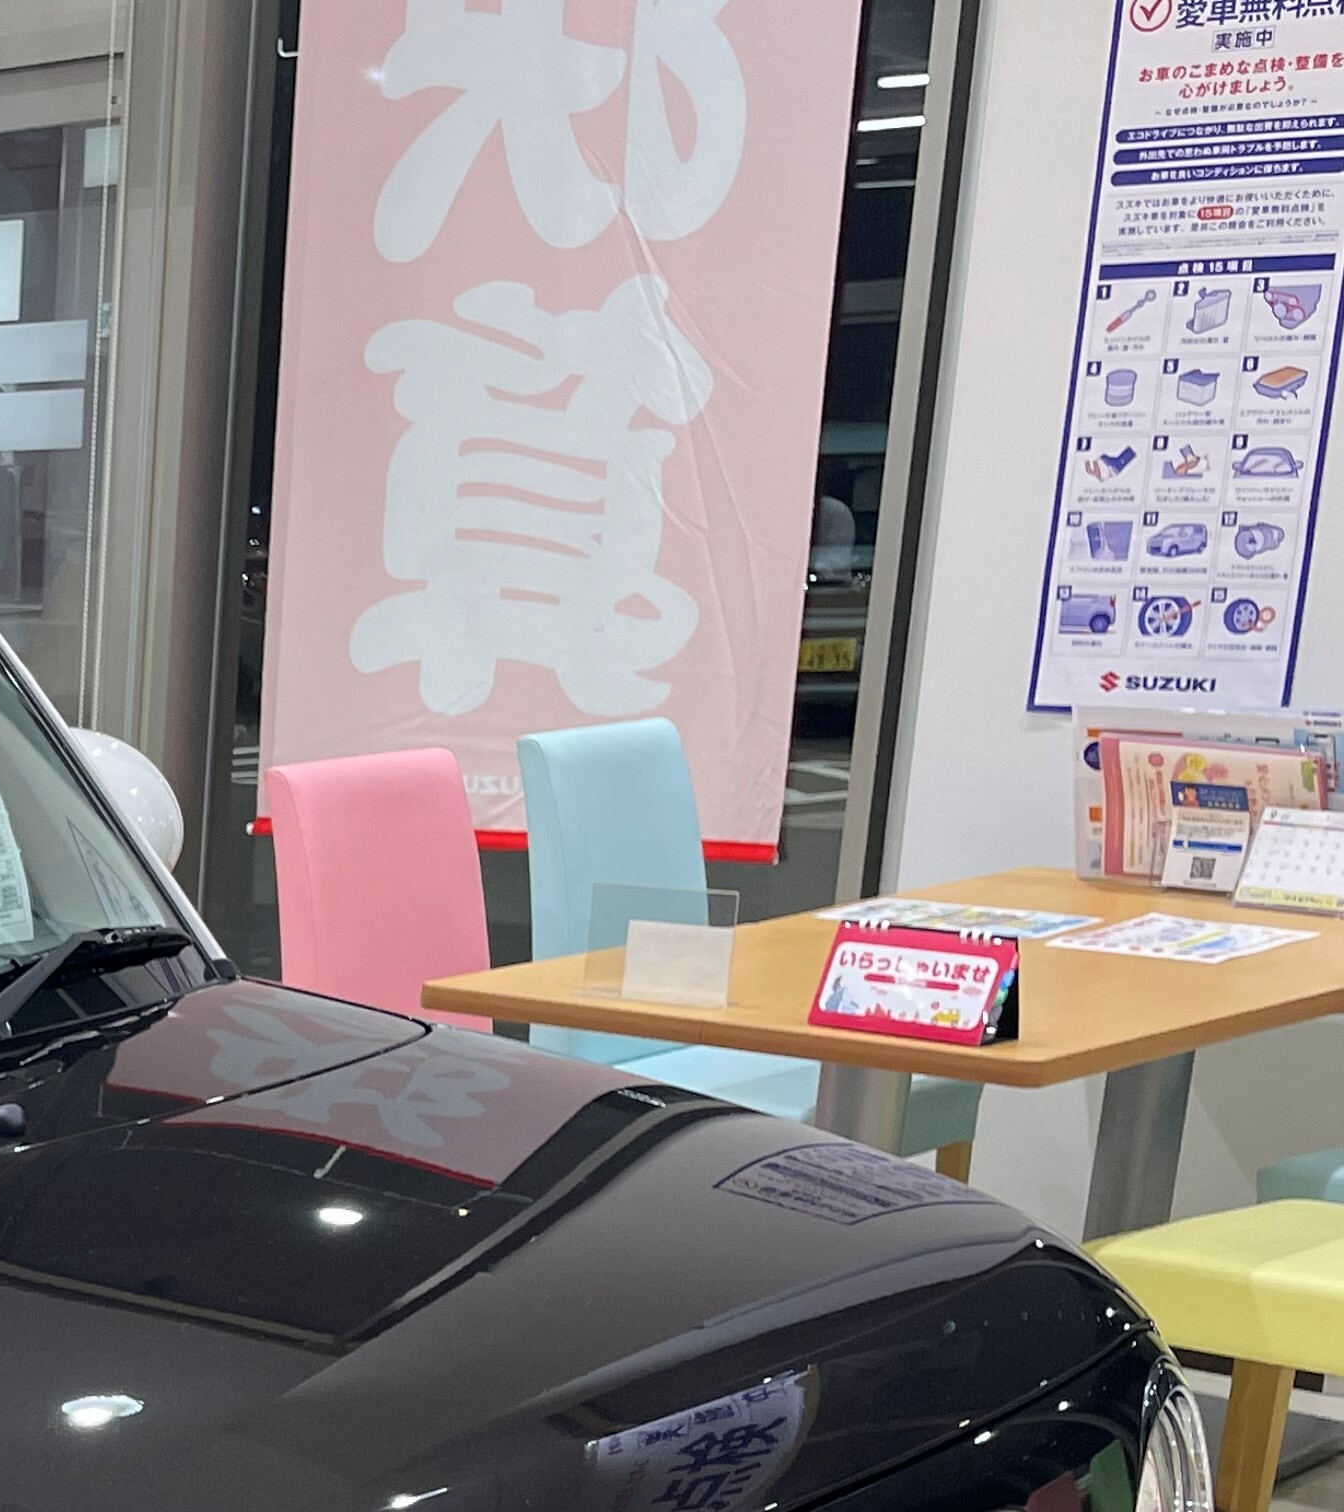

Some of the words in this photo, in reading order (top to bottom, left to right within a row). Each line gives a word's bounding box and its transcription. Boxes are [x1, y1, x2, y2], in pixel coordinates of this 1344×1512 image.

[1175, 0, 1344, 29] 愛車無料点
[1214, 28, 1274, 51] 実施中
[1178, 76, 1294, 99] 心がけましょう。
[1125, 675, 1216, 692] SUZUKI
